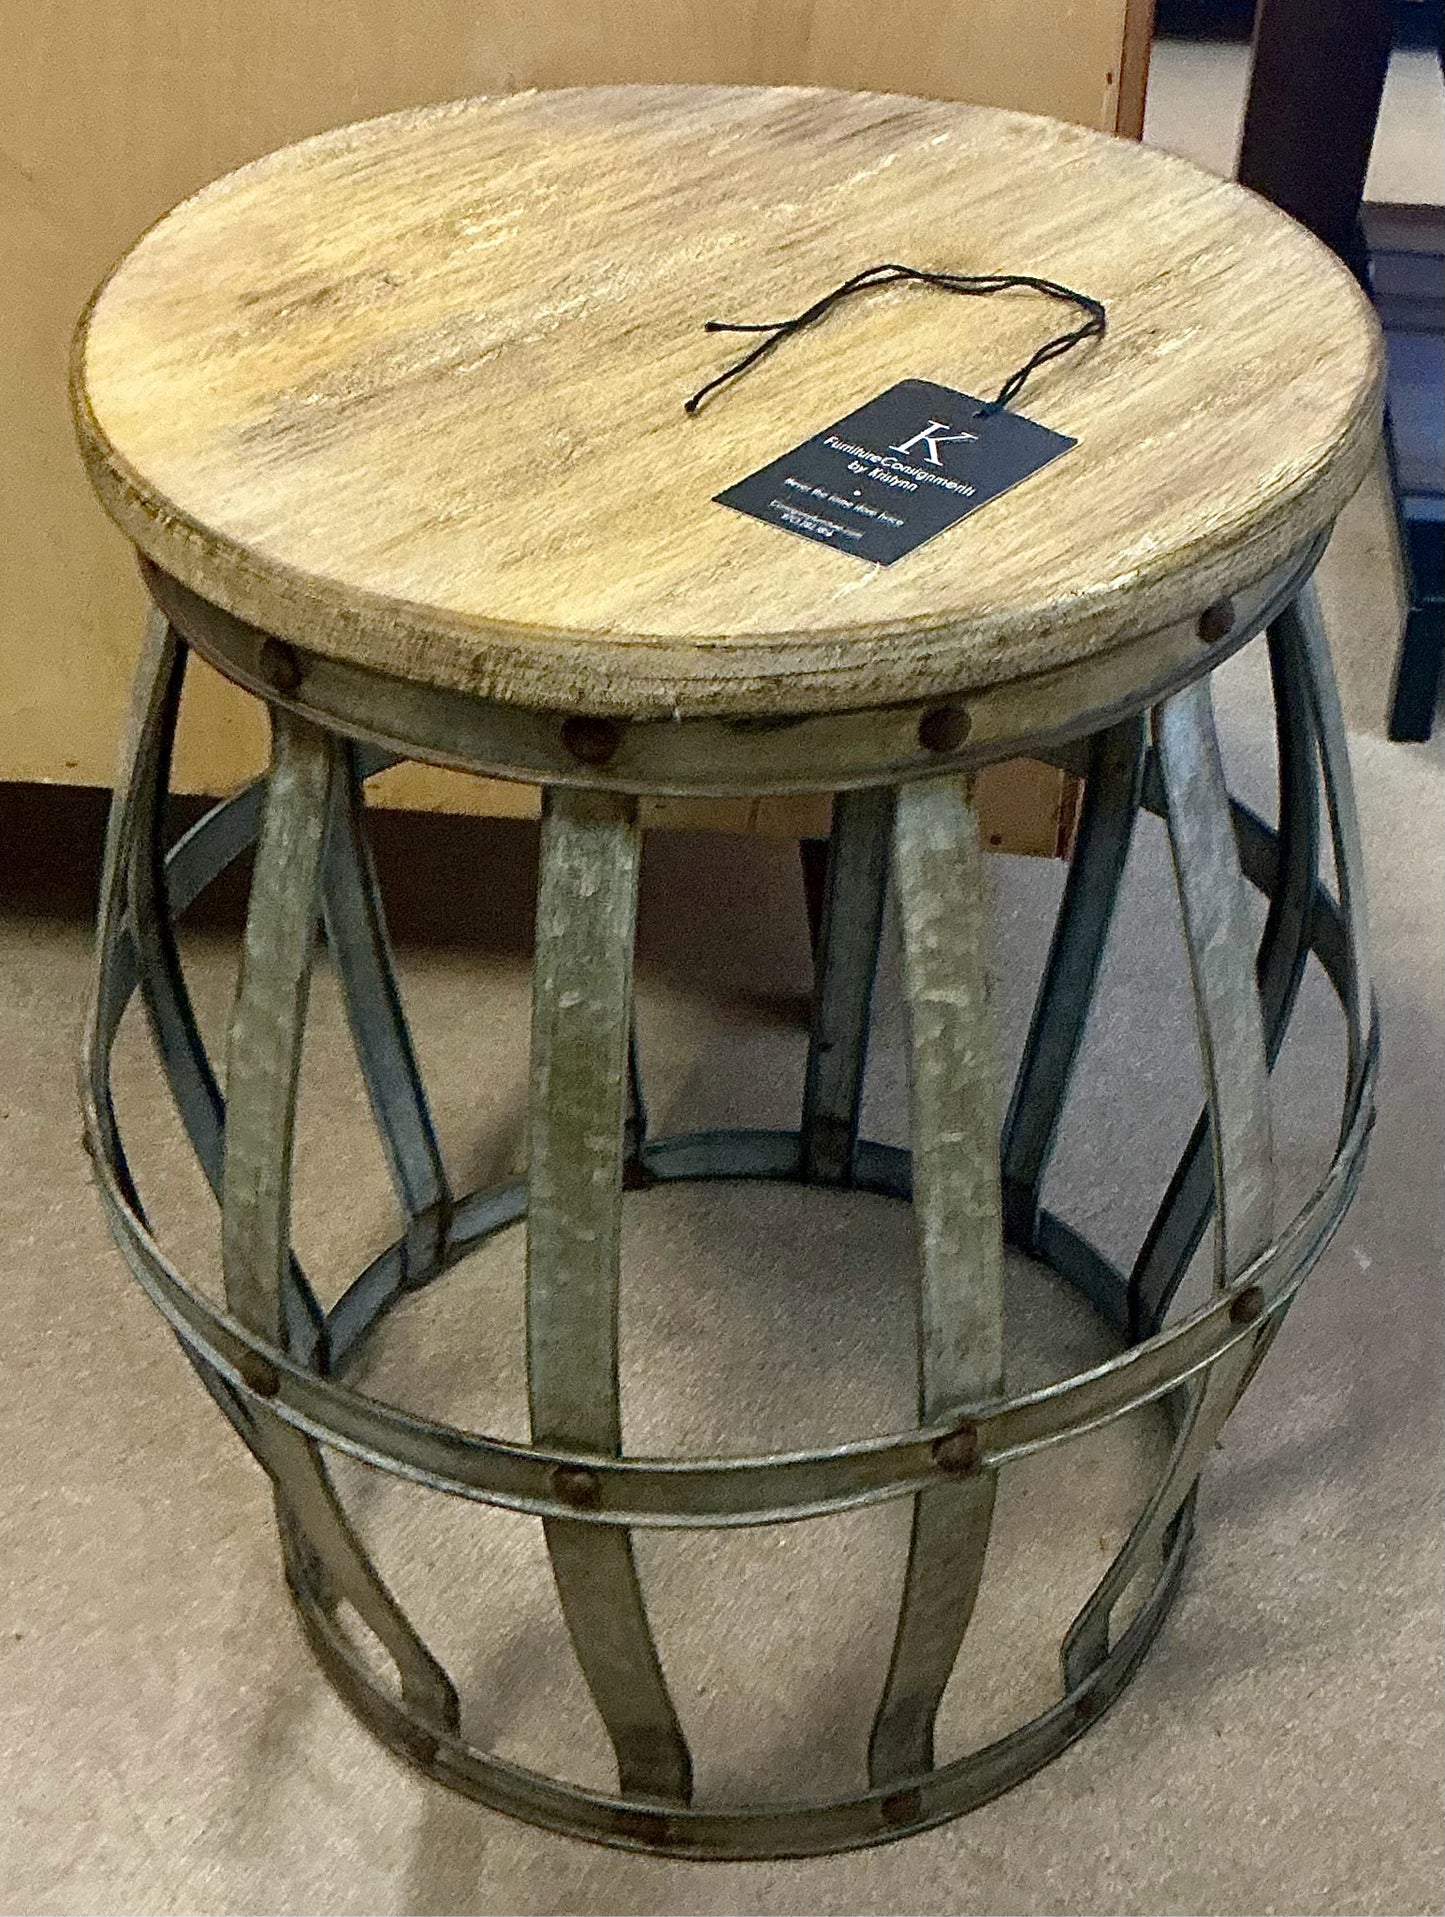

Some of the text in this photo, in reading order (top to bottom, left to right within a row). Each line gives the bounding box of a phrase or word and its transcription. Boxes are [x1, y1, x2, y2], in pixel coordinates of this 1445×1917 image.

[888, 419, 979, 467] K
[847, 460, 919, 492] by Kristynn
